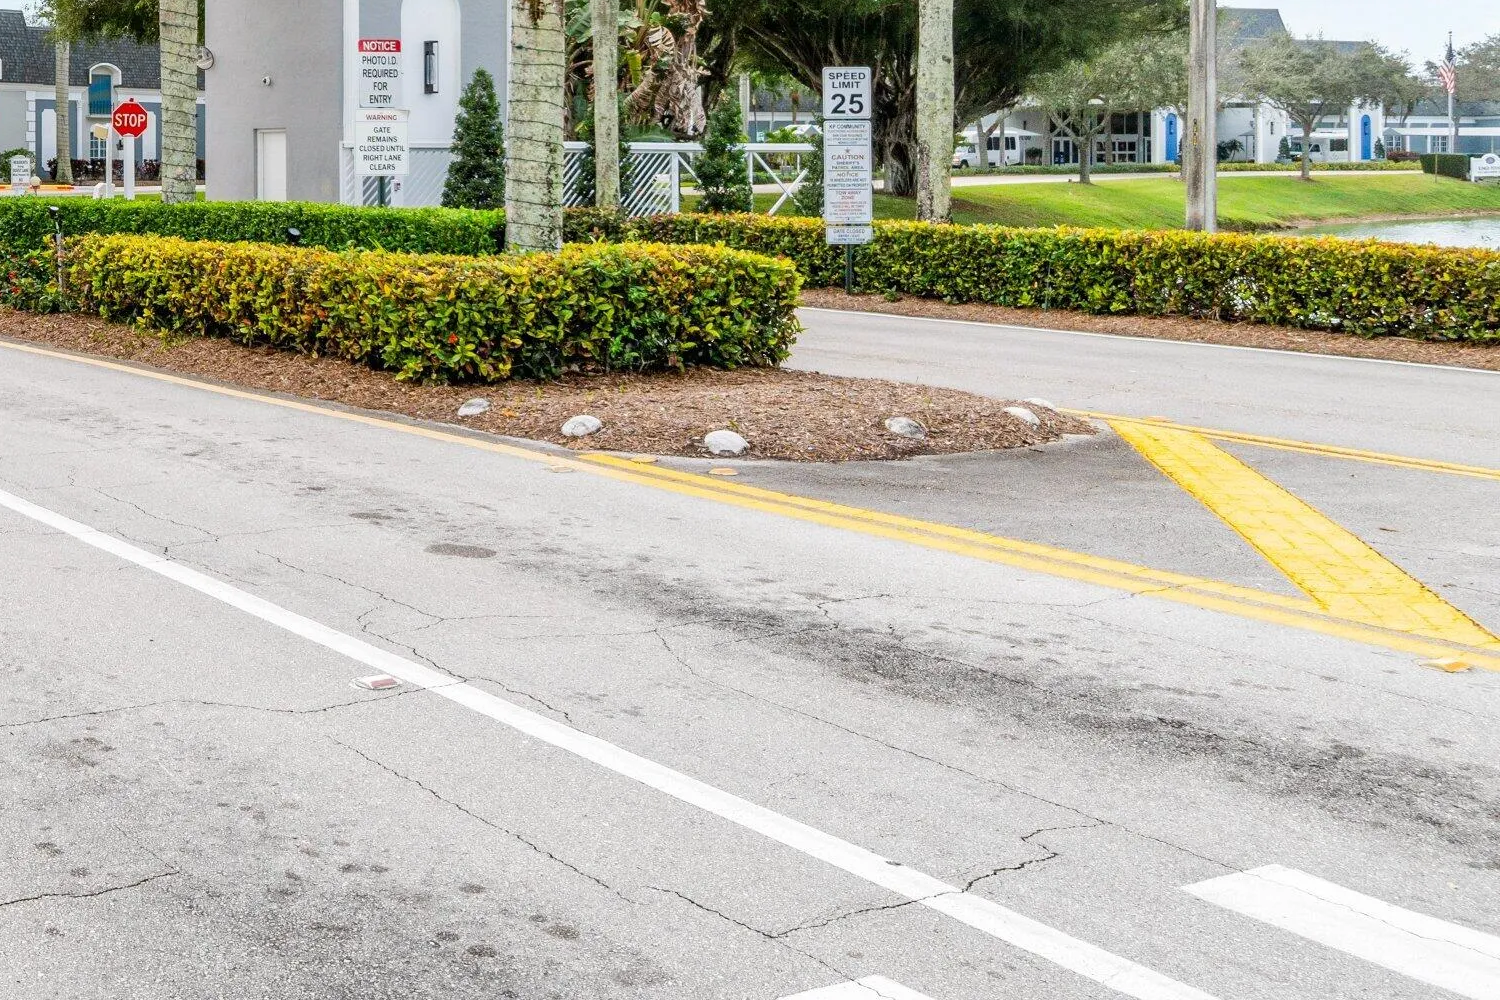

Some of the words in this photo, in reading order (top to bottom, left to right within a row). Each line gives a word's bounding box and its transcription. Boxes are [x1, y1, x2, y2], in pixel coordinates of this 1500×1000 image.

[362, 41, 397, 51] NOTICE
[362, 56, 387, 65] PHOTO
[362, 68, 399, 78] REQUIRED
[828, 72, 866, 80] SPEED
[373, 82, 388, 91] FOR
[831, 81, 861, 89] LIMIT
[369, 95, 393, 104] ENTRY
[830, 93, 864, 115] 25
[114, 113, 146, 128] STOP
[373, 126, 391, 134] GATE
[369, 163, 396, 171] CLEARS
